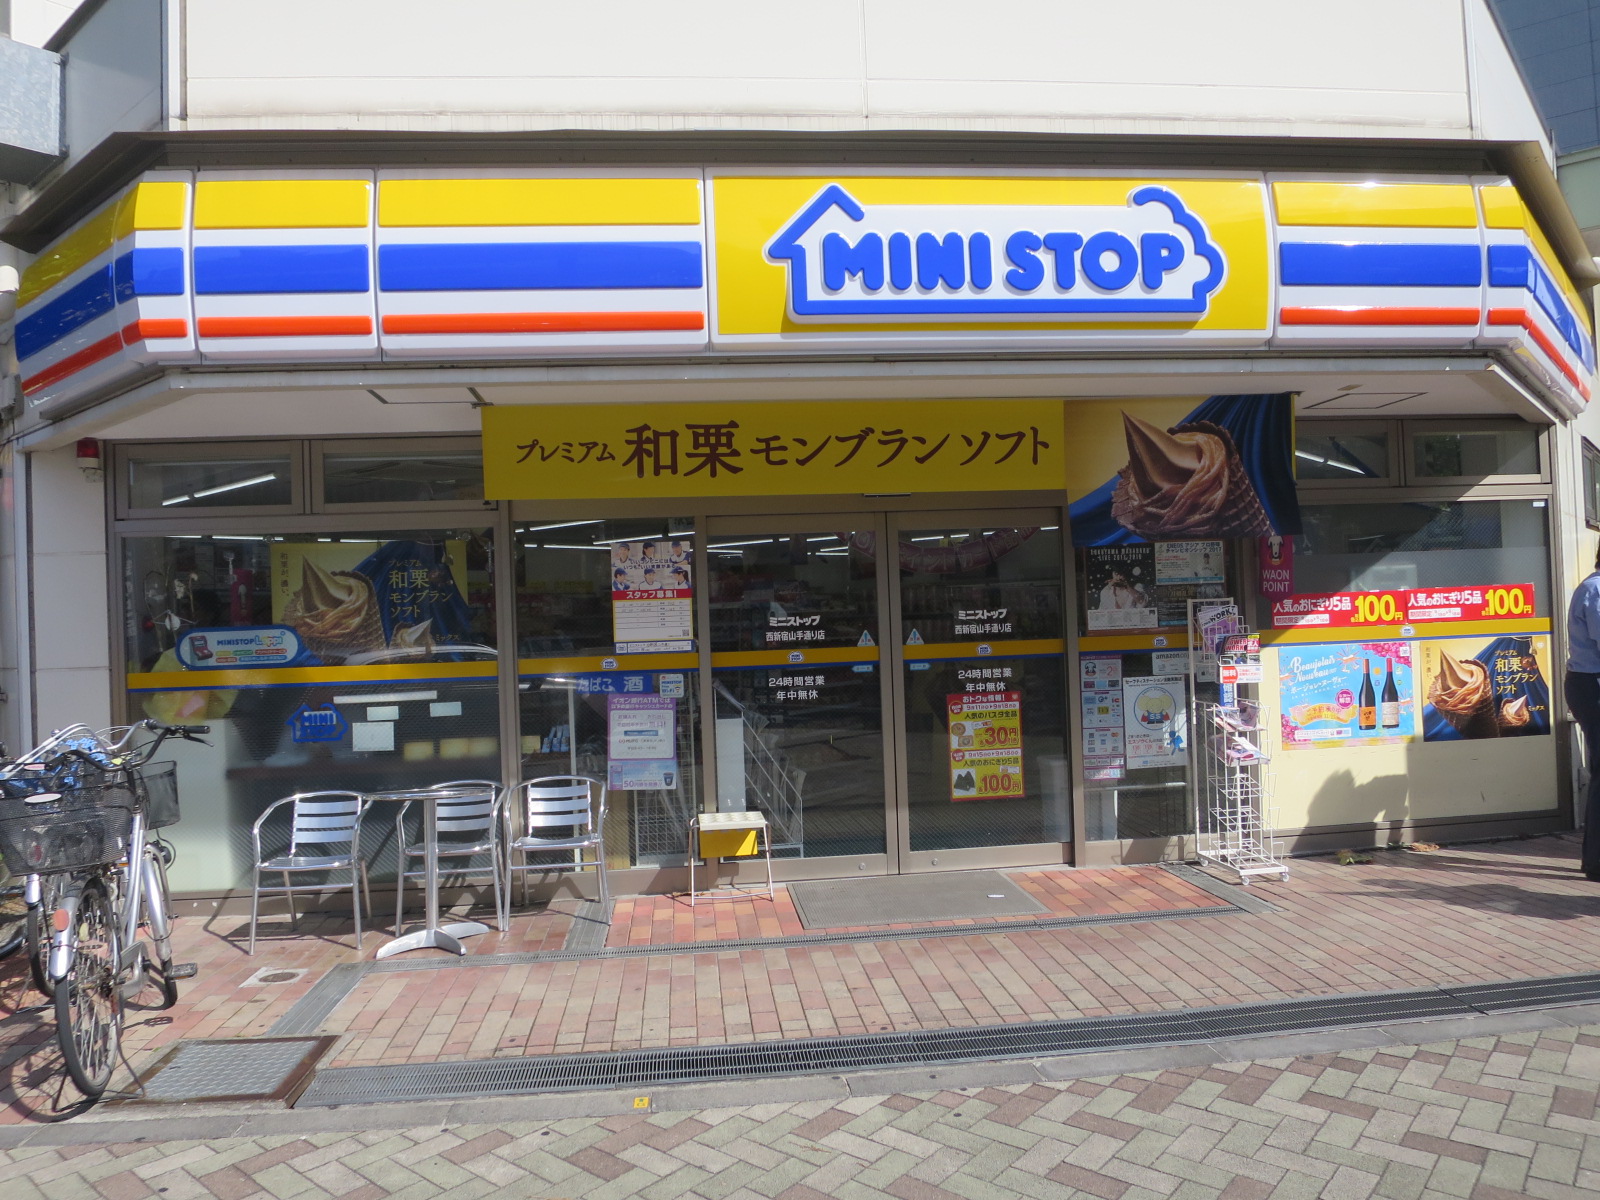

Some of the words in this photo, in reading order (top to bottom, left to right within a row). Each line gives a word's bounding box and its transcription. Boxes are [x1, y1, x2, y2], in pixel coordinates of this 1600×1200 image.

[822, 231, 992, 291] MINI
[1005, 230, 1185, 291] STOP
[388, 559, 422, 567] プレミアム
[388, 568, 430, 588] 和栗
[1262, 569, 1290, 580] WAON
[1262, 581, 1290, 593] POINT
[389, 589, 454, 604] モンブラン
[626, 590, 677, 599] スタッフ募集!
[1408, 590, 1482, 607] 人気のおにぎり5品
[390, 604, 421, 618] ソフト
[1273, 597, 1351, 613] 人気のおにぎり5品
[958, 608, 1007, 620] ミニストップ
[769, 615, 821, 627] ミニストップ
[954, 623, 1012, 635] 西新宿山手通り店
[216, 638, 255, 646] MINISTOP
[435, 633, 461, 642] ミックス
[765, 630, 825, 642] 西新宿山手通り店
[1290, 654, 1336, 674] Beaujolais
[1494, 657, 1523, 673] 和栗
[958, 667, 1013, 679] 24時間営業
[1294, 668, 1329, 683] Nouveau
[1496, 672, 1538, 684] モンブラン
[578, 676, 616, 692] たばこ
[623, 676, 644, 692] 酒
[768, 675, 825, 687] 24時間営業
[965, 681, 1006, 692] 年中無休
[776, 689, 819, 700] 年中無休
[1496, 685, 1517, 695] ソフト
[962, 694, 1005, 703] おトクな情報!
[964, 711, 1018, 720] 人気のパスタ全品
[963, 758, 1019, 767] 人気のおにぎり5品
